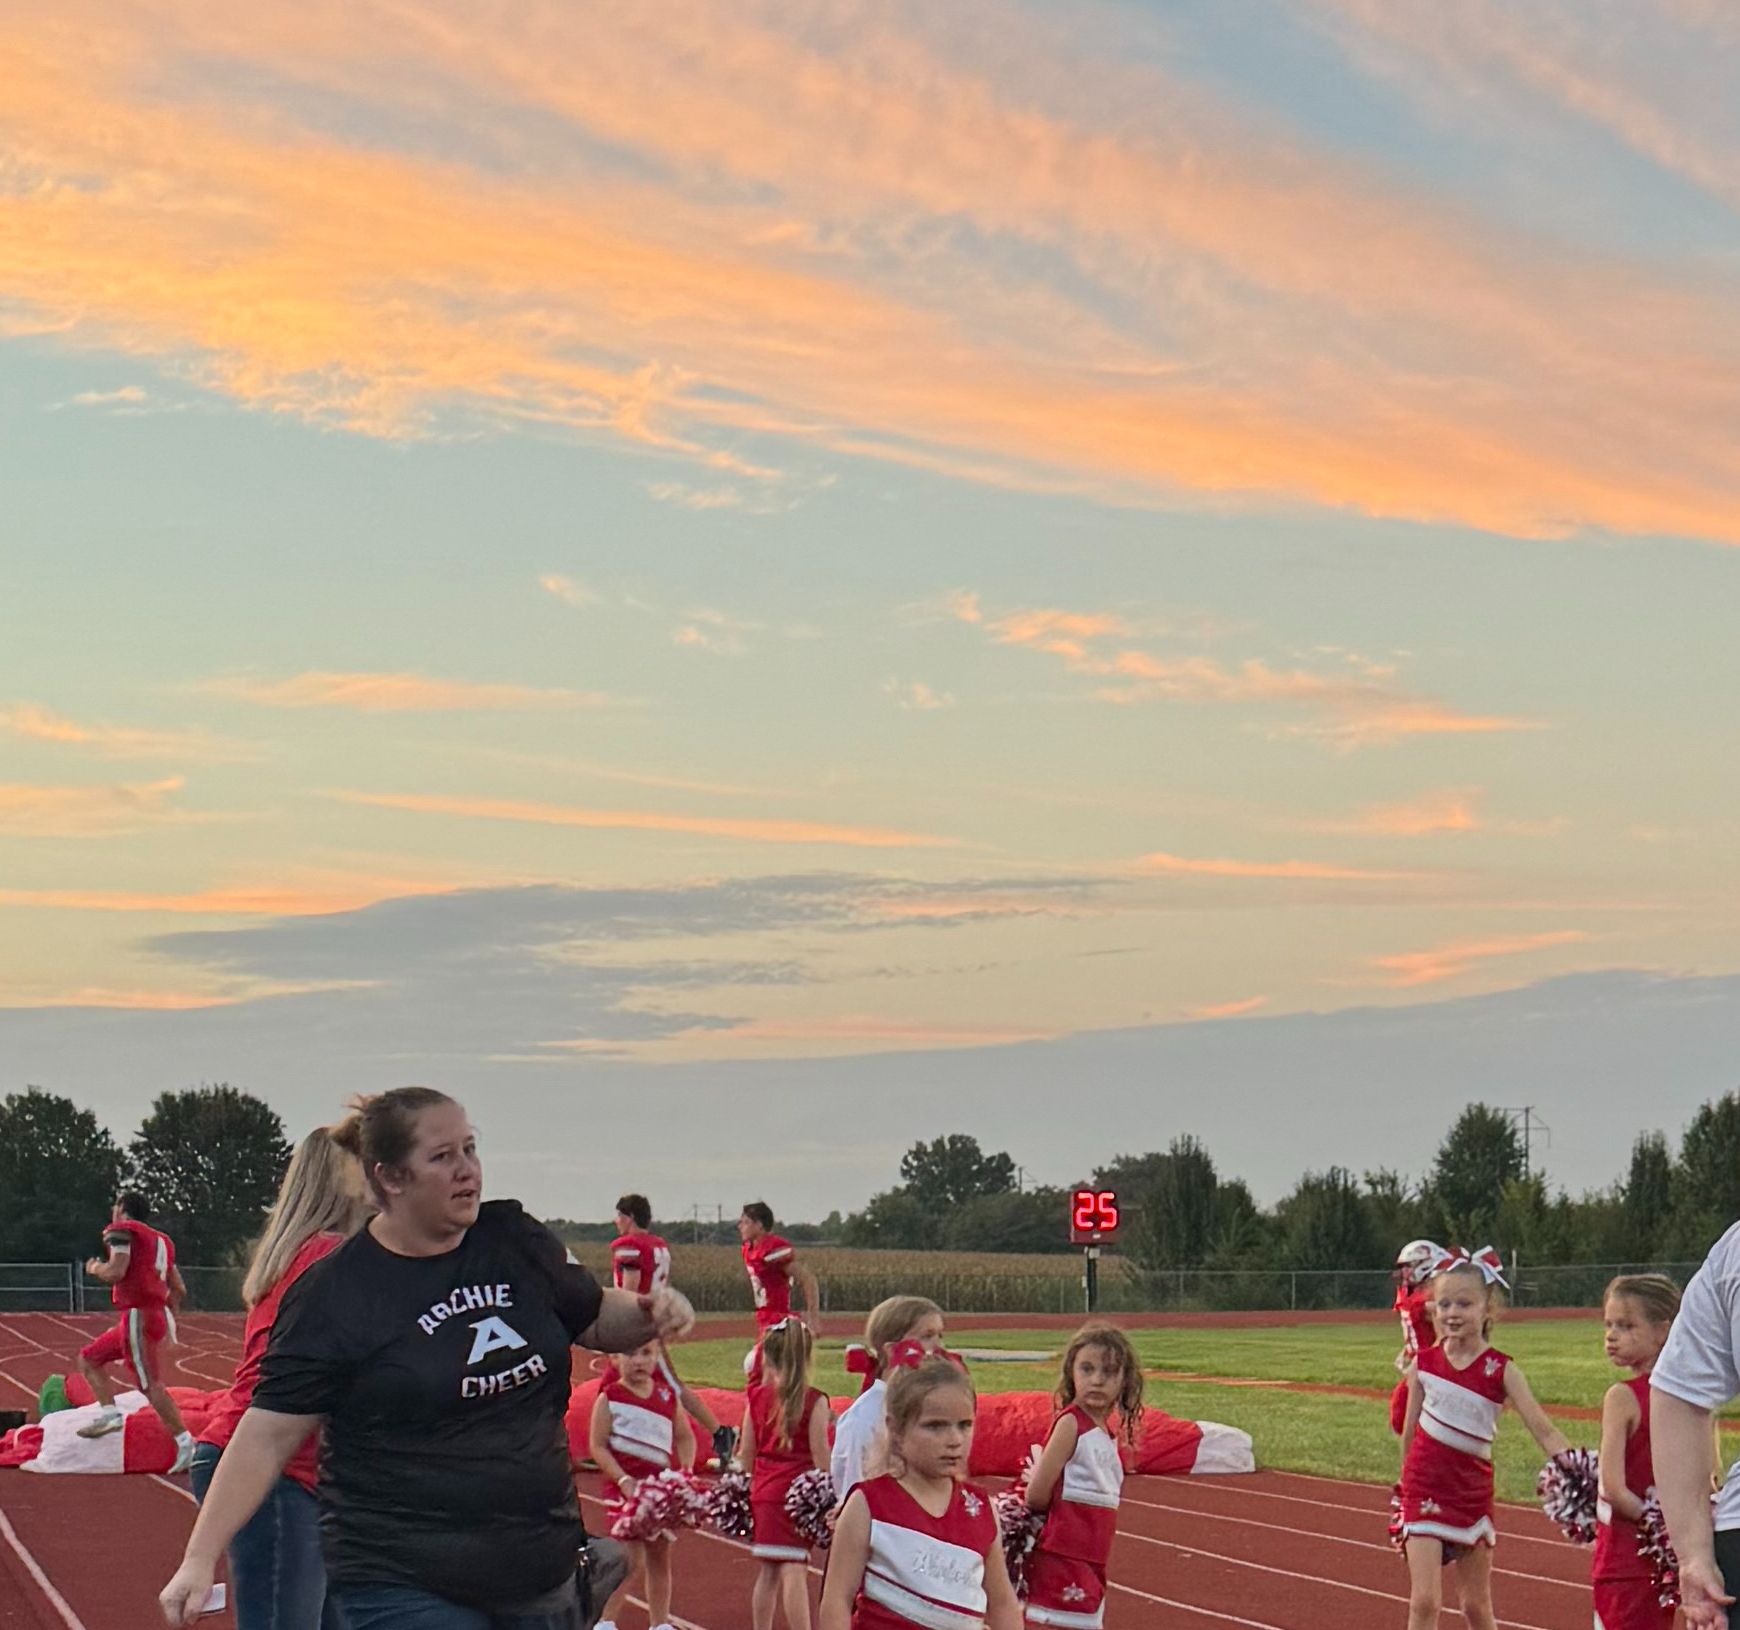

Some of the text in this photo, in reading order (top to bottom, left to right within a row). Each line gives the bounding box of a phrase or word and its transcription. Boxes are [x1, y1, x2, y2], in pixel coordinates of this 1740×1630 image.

[1075, 1191, 1118, 1229] 25
[417, 1283, 513, 1335] ARCHIE
[466, 1316, 528, 1365] A
[461, 1354, 547, 1398] CHEER
